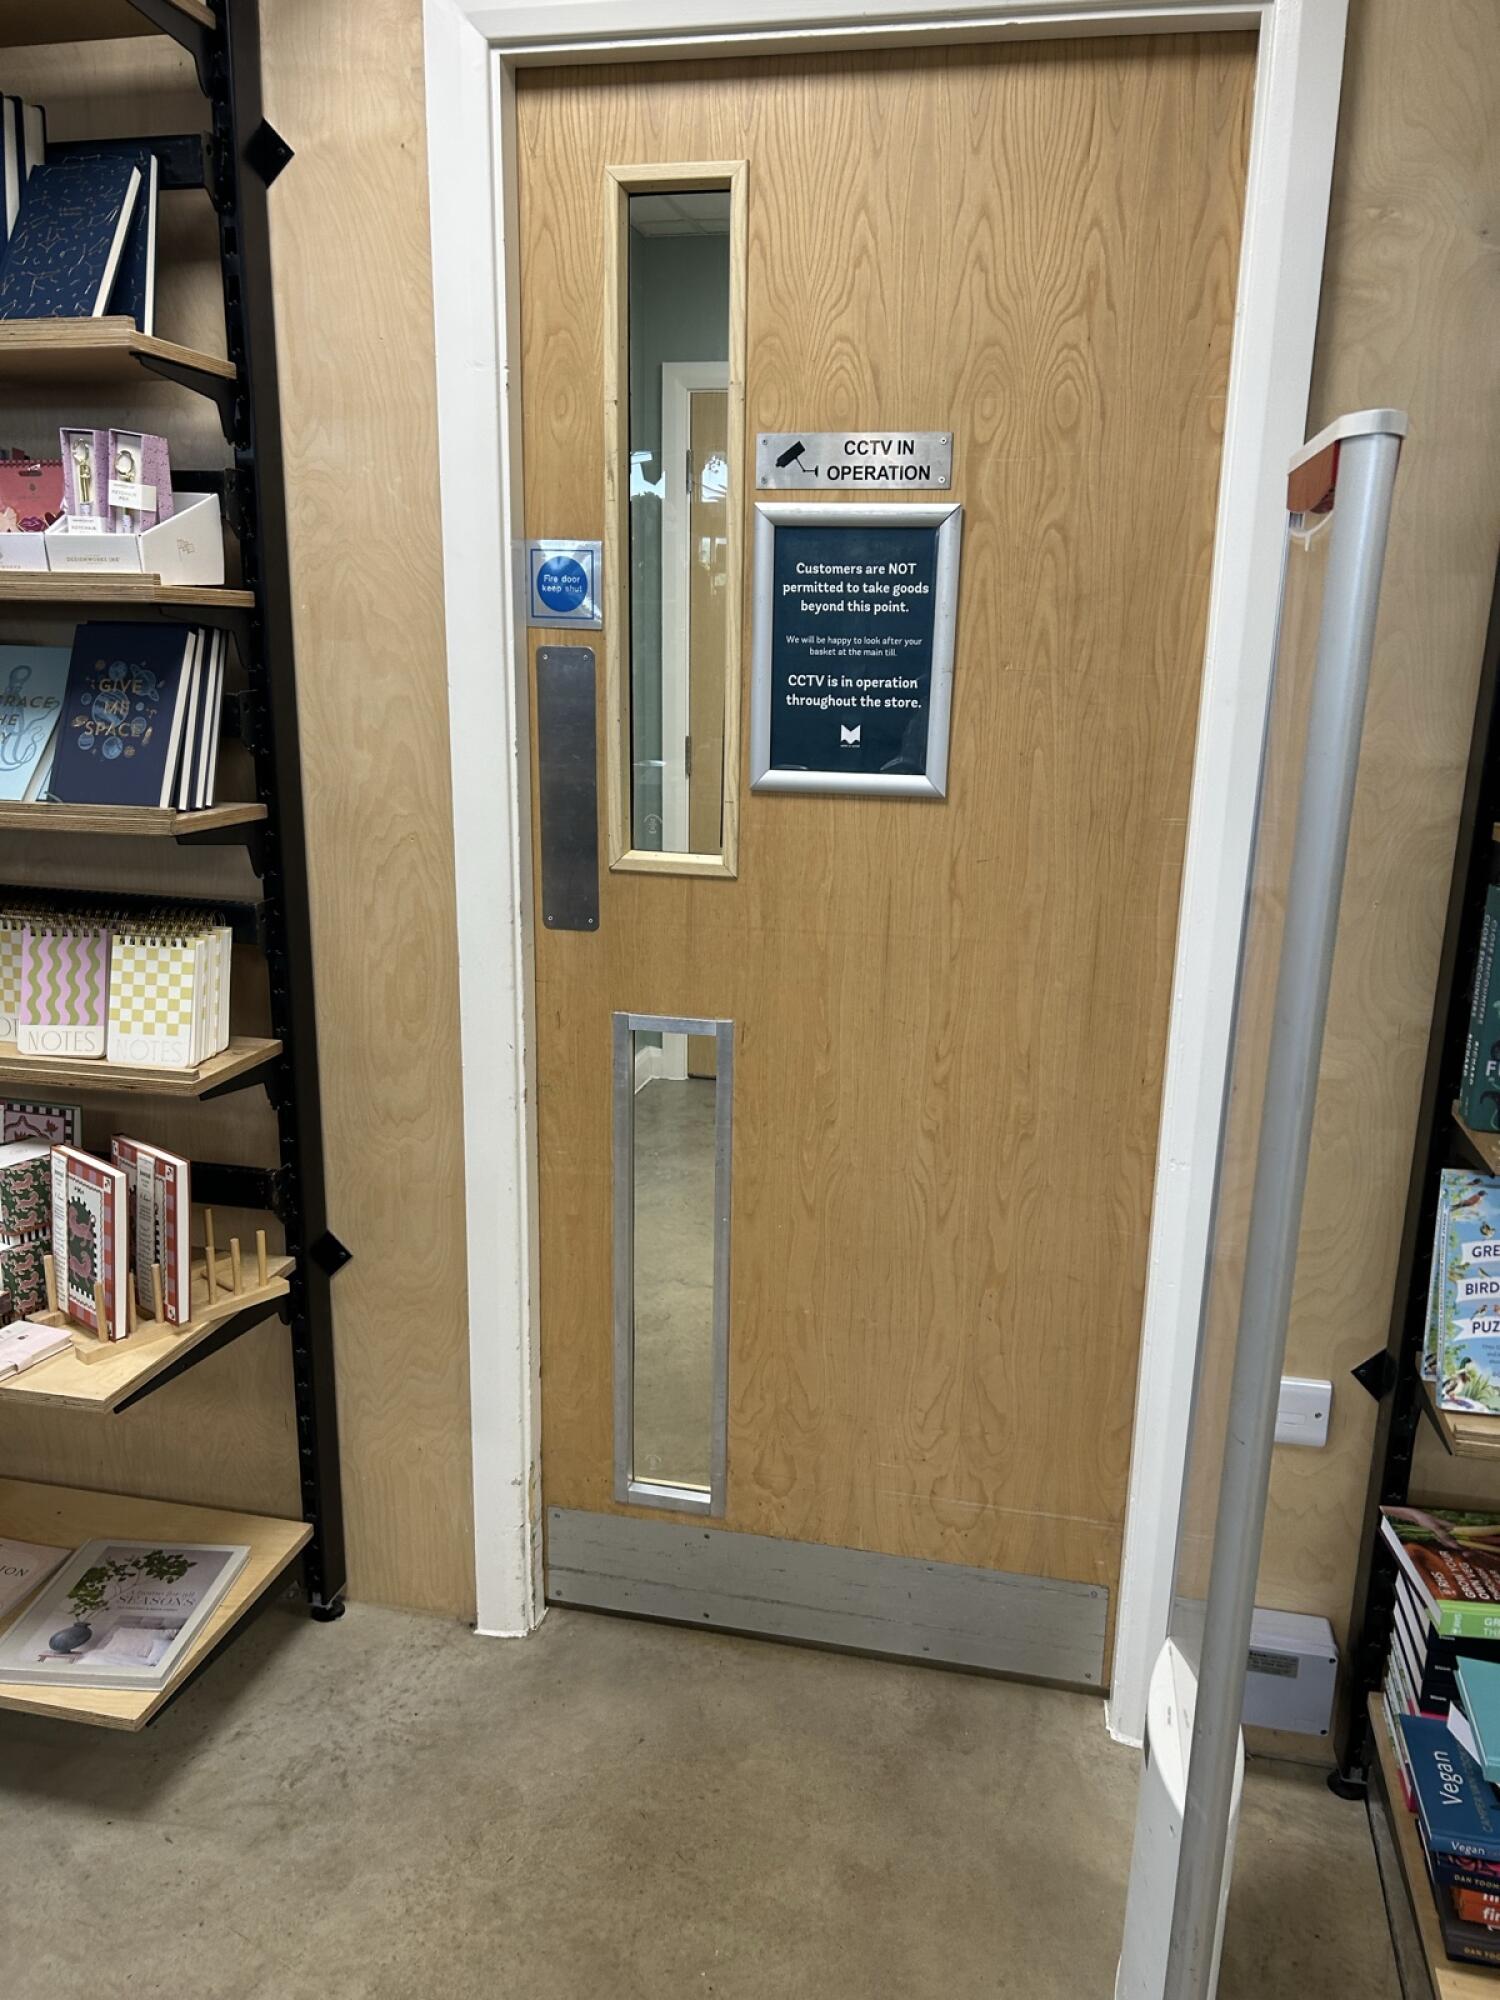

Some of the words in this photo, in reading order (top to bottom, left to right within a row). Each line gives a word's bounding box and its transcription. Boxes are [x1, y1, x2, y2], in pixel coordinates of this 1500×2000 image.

[844, 440, 893, 456] CCTV
[897, 440, 915, 455] IN
[827, 465, 931, 480] OPERATION
[796, 562, 863, 575] Customers
[865, 565, 885, 575] are
[888, 563, 917, 575] NOT
[543, 574, 558, 582] Fire
[561, 574, 580, 583] door
[542, 584, 561, 593] keep
[783, 581, 844, 595] permitted
[847, 583, 860, 593] to
[863, 582, 890, 594] take
[892, 582, 929, 596] goods
[801, 600, 845, 614] beyond
[847, 600, 871, 612] this
[874, 600, 909, 615] point.
[786, 635, 800, 643] We
[801, 635, 815, 644] will
[816, 636, 826, 644] be
[827, 636, 851, 646] happy
[853, 637, 862, 645] to
[864, 636, 880, 645] look
[882, 636, 902, 645] after
[904, 638, 922, 647] your
[809, 647, 836, 656] basket
[848, 648, 862, 656] the
[99, 678, 143, 694] GIVE
[788, 674, 825, 687] CCTV
[827, 675, 838, 687] is
[841, 676, 853, 688] in
[855, 676, 918, 690] operation
[0, 694, 57, 708] RACE
[104, 700, 130, 715] ME
[786, 694, 857, 709] throughout
[860, 695, 881, 707] the
[884, 696, 922, 708] store.
[84, 720, 141, 737] SPACE
[28, 1030, 97, 1052] NOTES
[116, 1038, 184, 1063] NOTES
[1485, 1061, 1500, 1076] F
[1435, 1751, 1463, 1804] Vegan
[1451, 1841, 1486, 1856] Vegan
